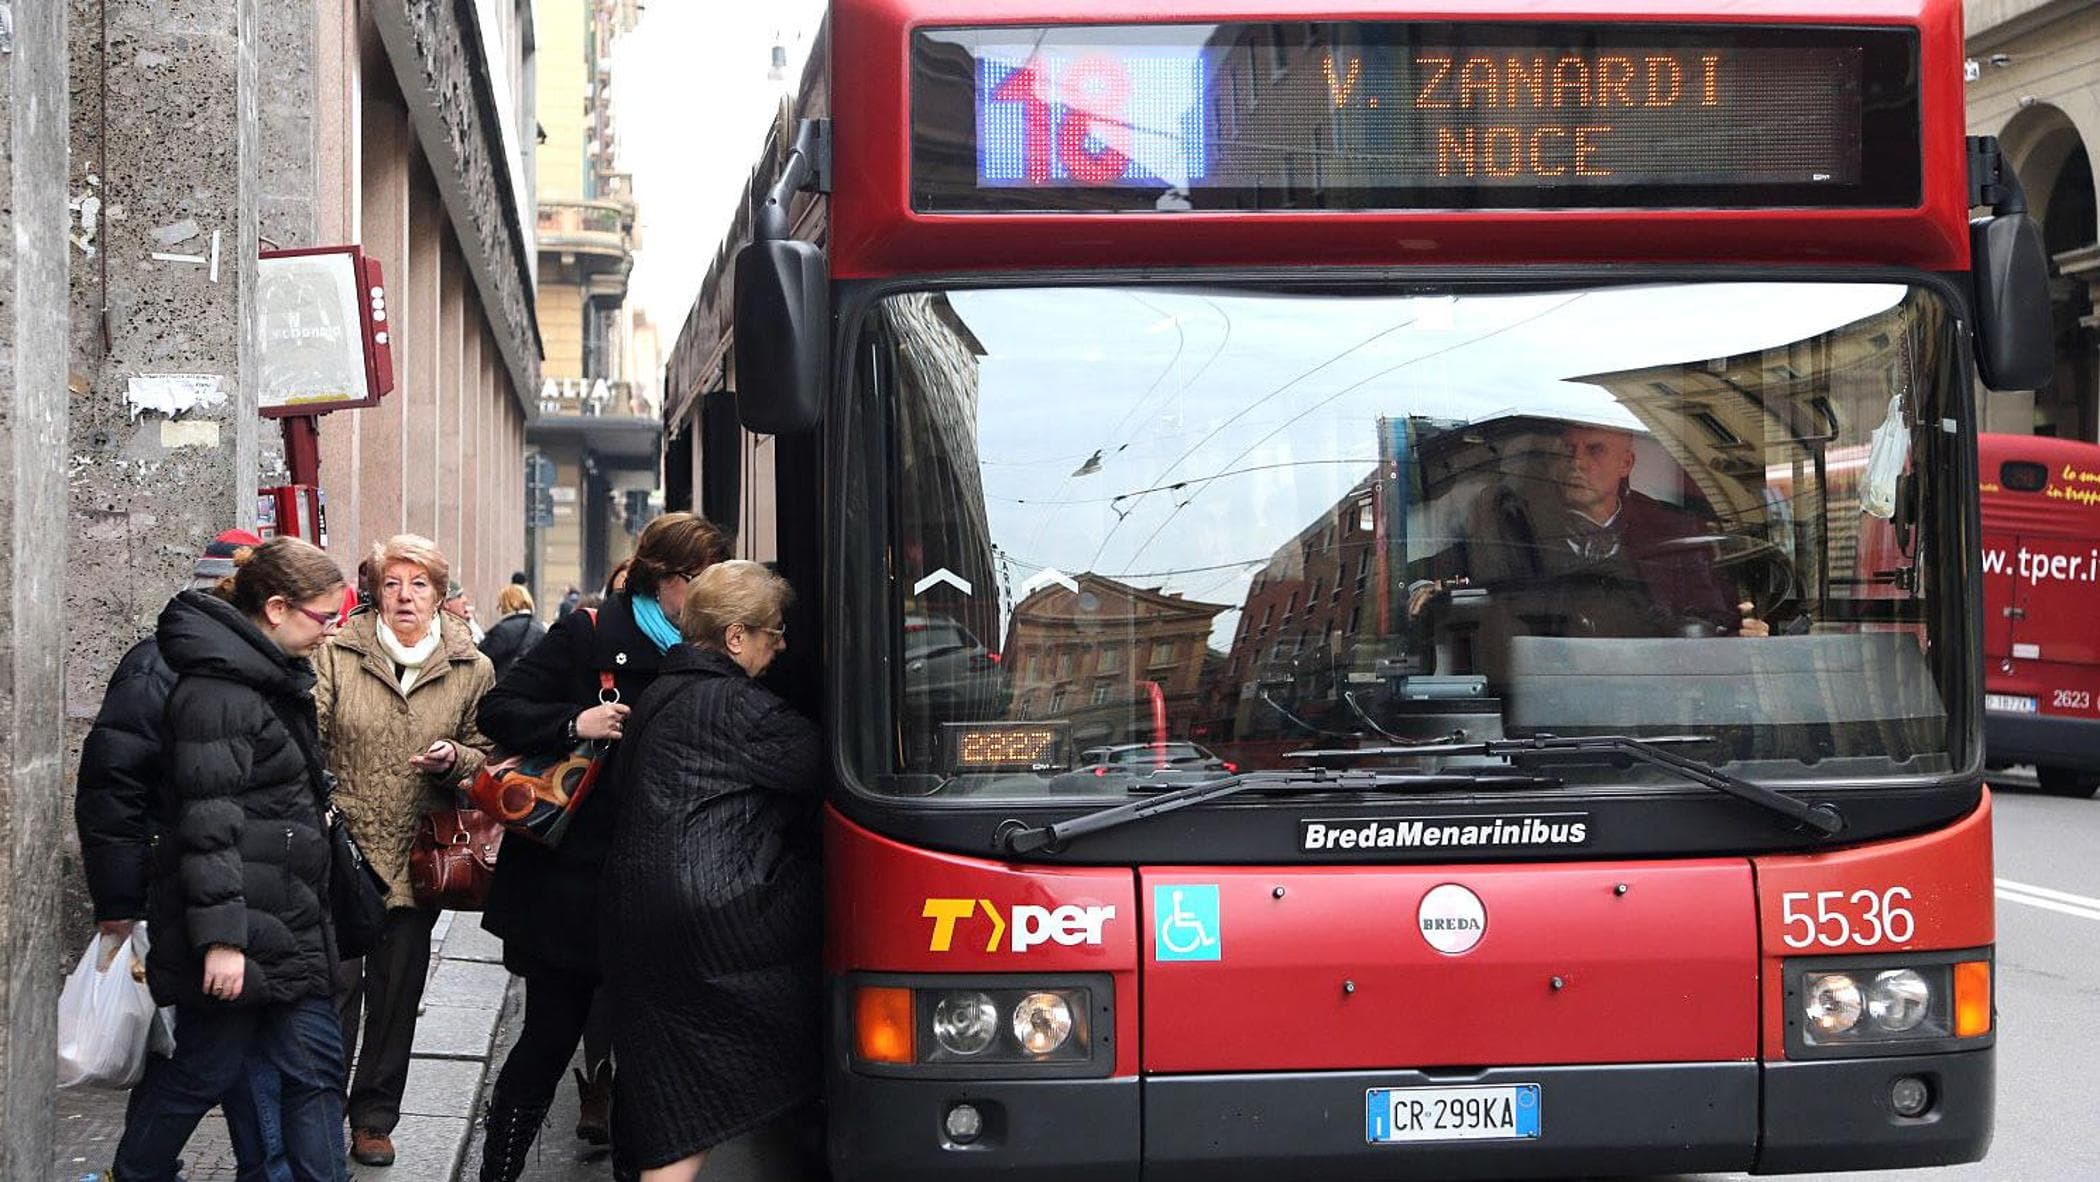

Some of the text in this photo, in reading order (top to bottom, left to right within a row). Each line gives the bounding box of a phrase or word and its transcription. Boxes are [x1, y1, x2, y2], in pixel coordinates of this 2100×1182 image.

[1322, 55, 1719, 109] V. ZANARDI
[990, 55, 1135, 185] 18
[1437, 126, 1615, 178] NOCE
[1982, 547, 2100, 586] w.tper.i
[2053, 689, 2091, 710] 2623
[964, 731, 1052, 761] 2227
[1305, 819, 1586, 849] BredaMenarinibus
[1422, 917, 1481, 931] BREDA
[1782, 886, 1915, 948] 5536
